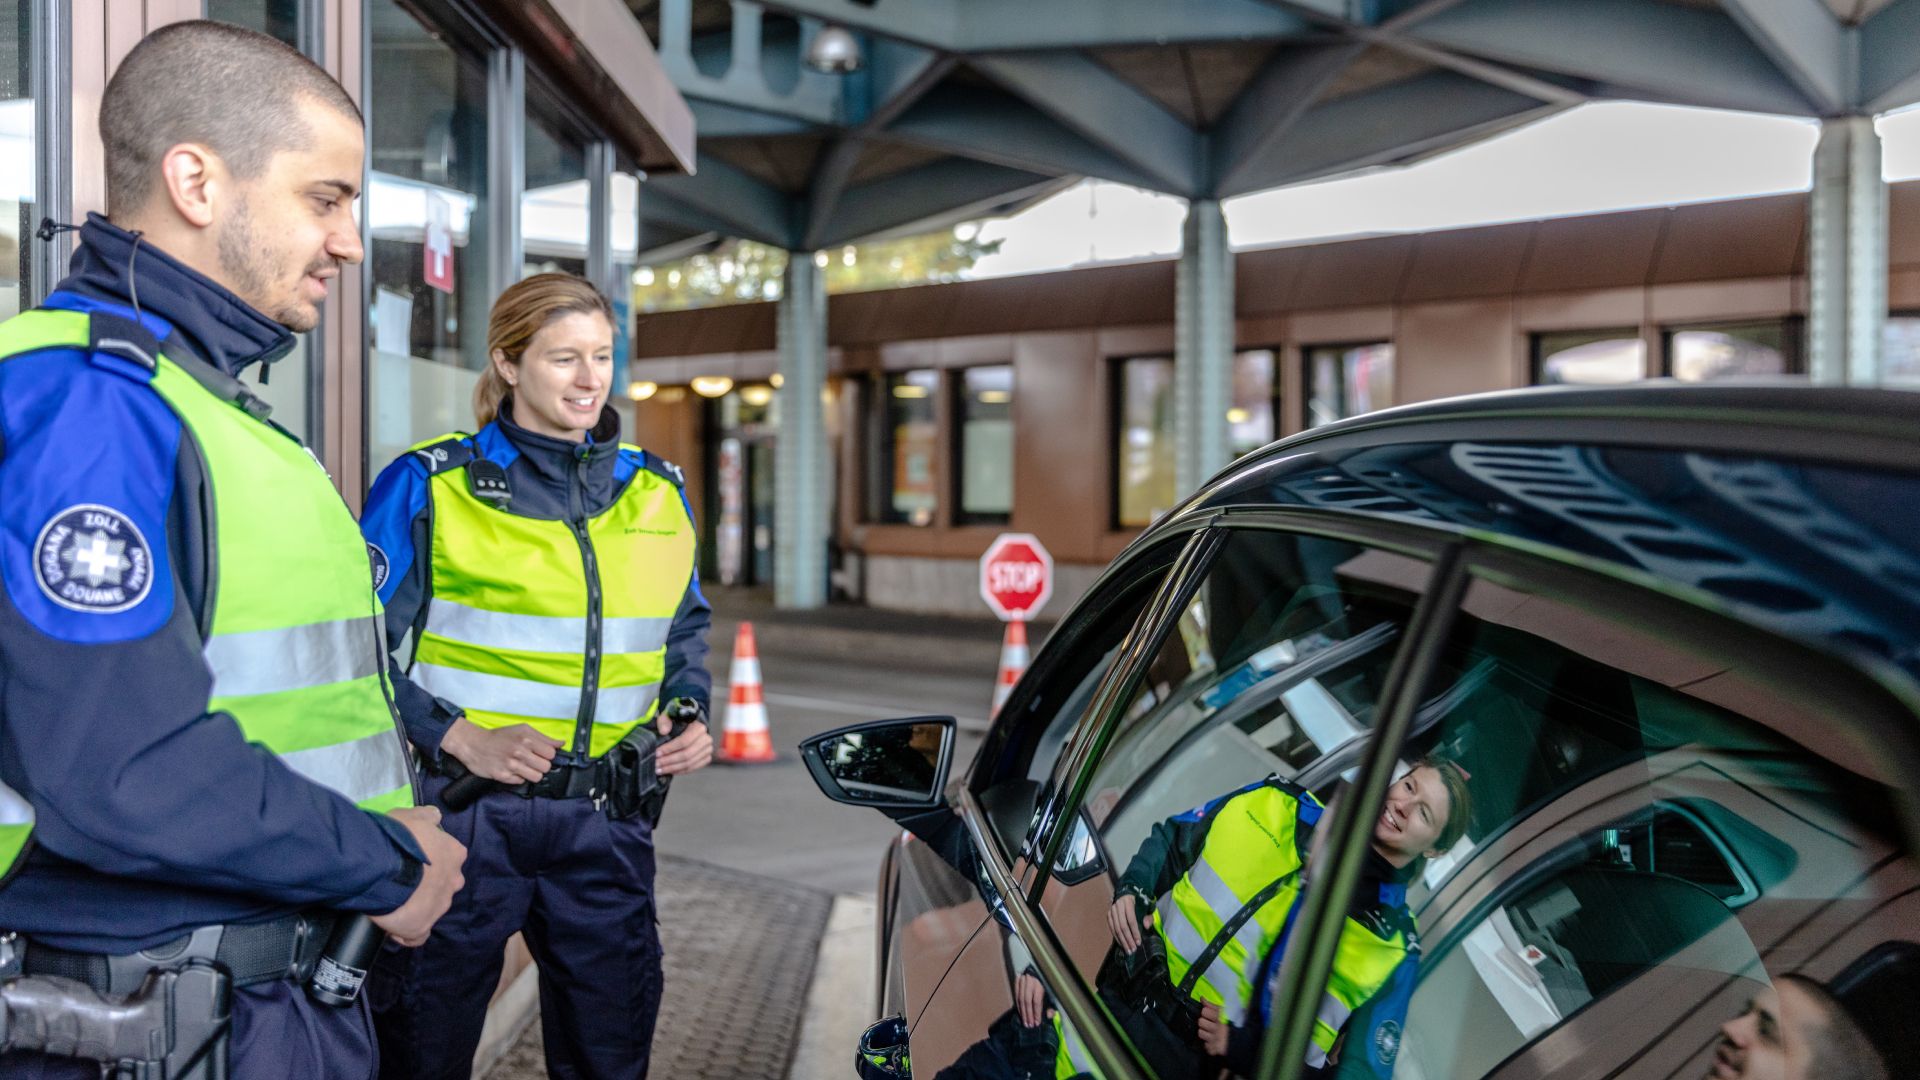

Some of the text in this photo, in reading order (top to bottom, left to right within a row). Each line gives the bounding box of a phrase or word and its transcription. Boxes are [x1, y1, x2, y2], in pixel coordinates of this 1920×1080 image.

[85, 513, 120, 533] ZOLL
[989, 561, 1041, 593] STOP
[63, 582, 125, 603] DOUANE
